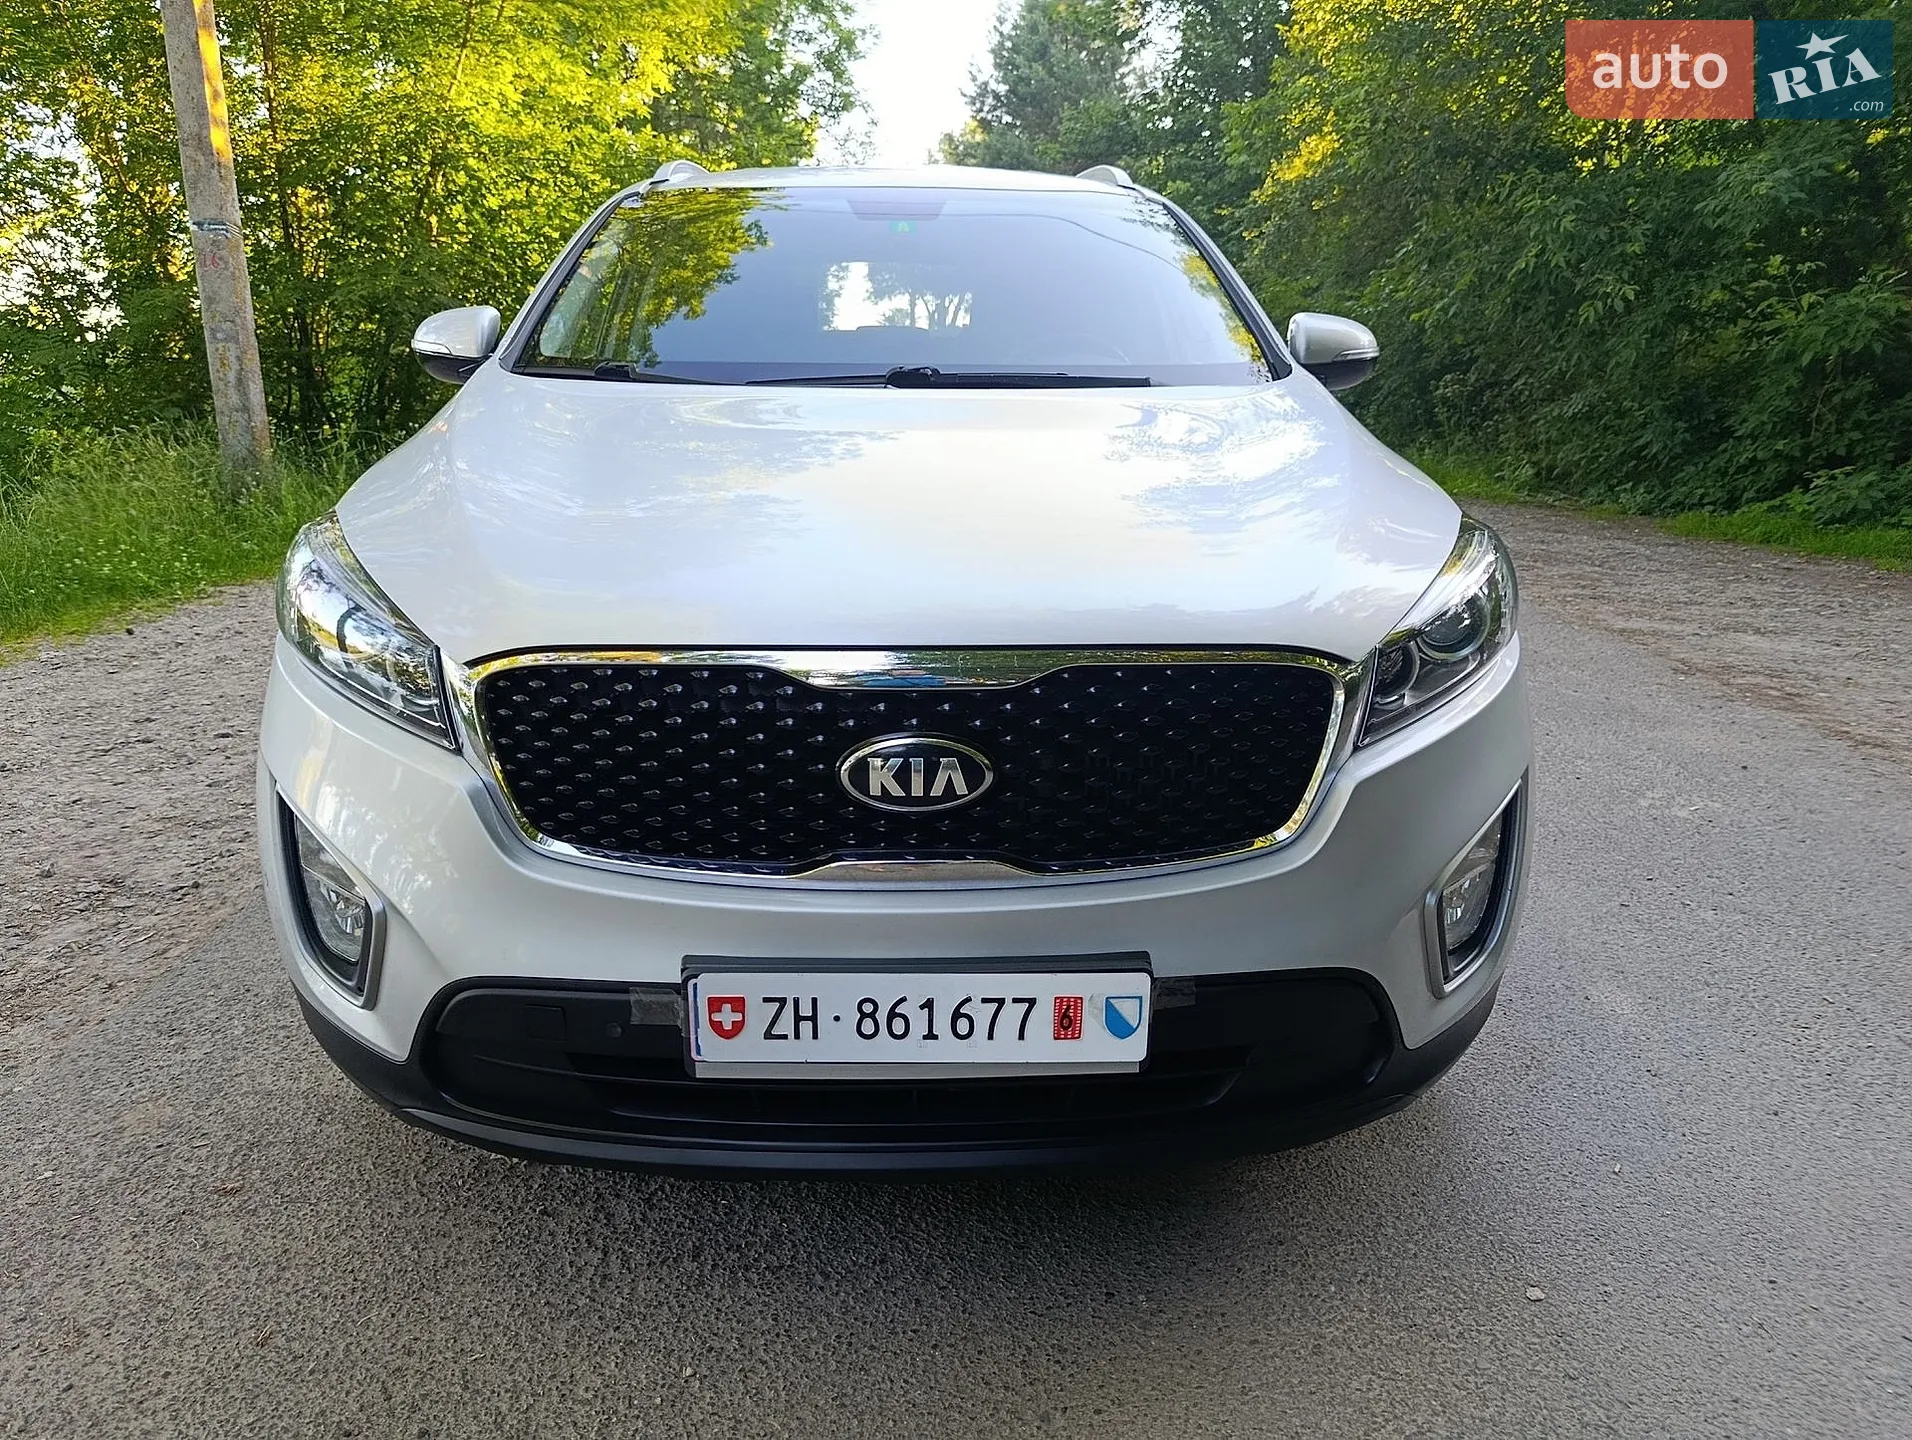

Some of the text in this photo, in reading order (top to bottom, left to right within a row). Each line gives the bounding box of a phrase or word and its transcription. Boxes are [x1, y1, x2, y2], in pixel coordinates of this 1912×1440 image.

[867, 757, 969, 797] KIA
[855, 995, 1037, 1040] 861677
[1060, 1004, 1073, 1030] 6
